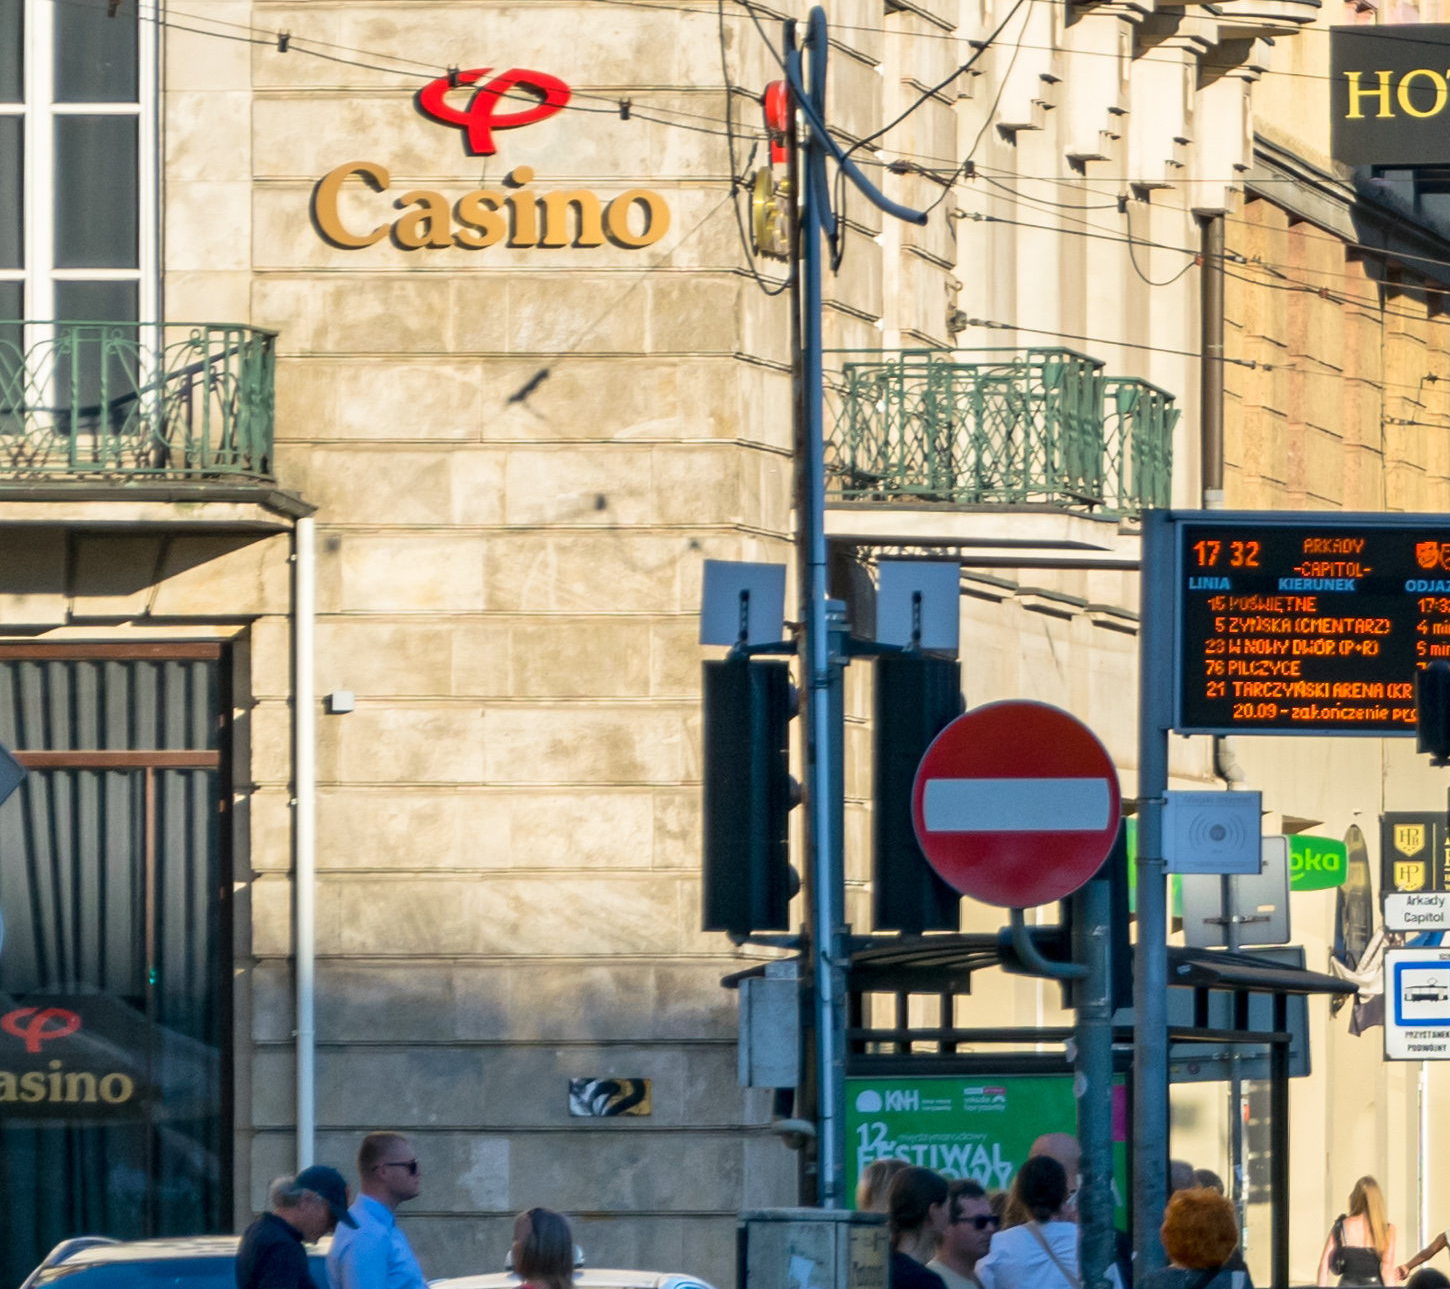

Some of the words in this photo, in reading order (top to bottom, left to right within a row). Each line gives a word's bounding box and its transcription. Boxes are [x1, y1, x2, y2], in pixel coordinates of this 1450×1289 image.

[311, 160, 672, 250] Casino
[1193, 540, 1221, 567] 17
[1230, 540, 1261, 567] 32
[1303, 538, 1365, 554] ARKADY
[1189, 577, 1230, 591] LINIA
[1278, 577, 1356, 592] KIERUNEK
[1215, 617, 1226, 633] 5
[1417, 619, 1428, 635] 4
[1416, 641, 1427, 656] 5
[1205, 660, 1225, 676] 76
[1228, 660, 1301, 676] PILCZYCE
[1206, 681, 1225, 697] 21
[1233, 680, 1329, 698] TARCZYŃSKI
[1332, 682, 1383, 699] ARENA
[1233, 703, 1277, 719] 20.09
[1292, 701, 1389, 721] zakończenie
[1406, 895, 1445, 908] Arkady
[1403, 911, 1444, 924] Capitol
[1404, 1030, 1450, 1040] PRZYSTANEK
